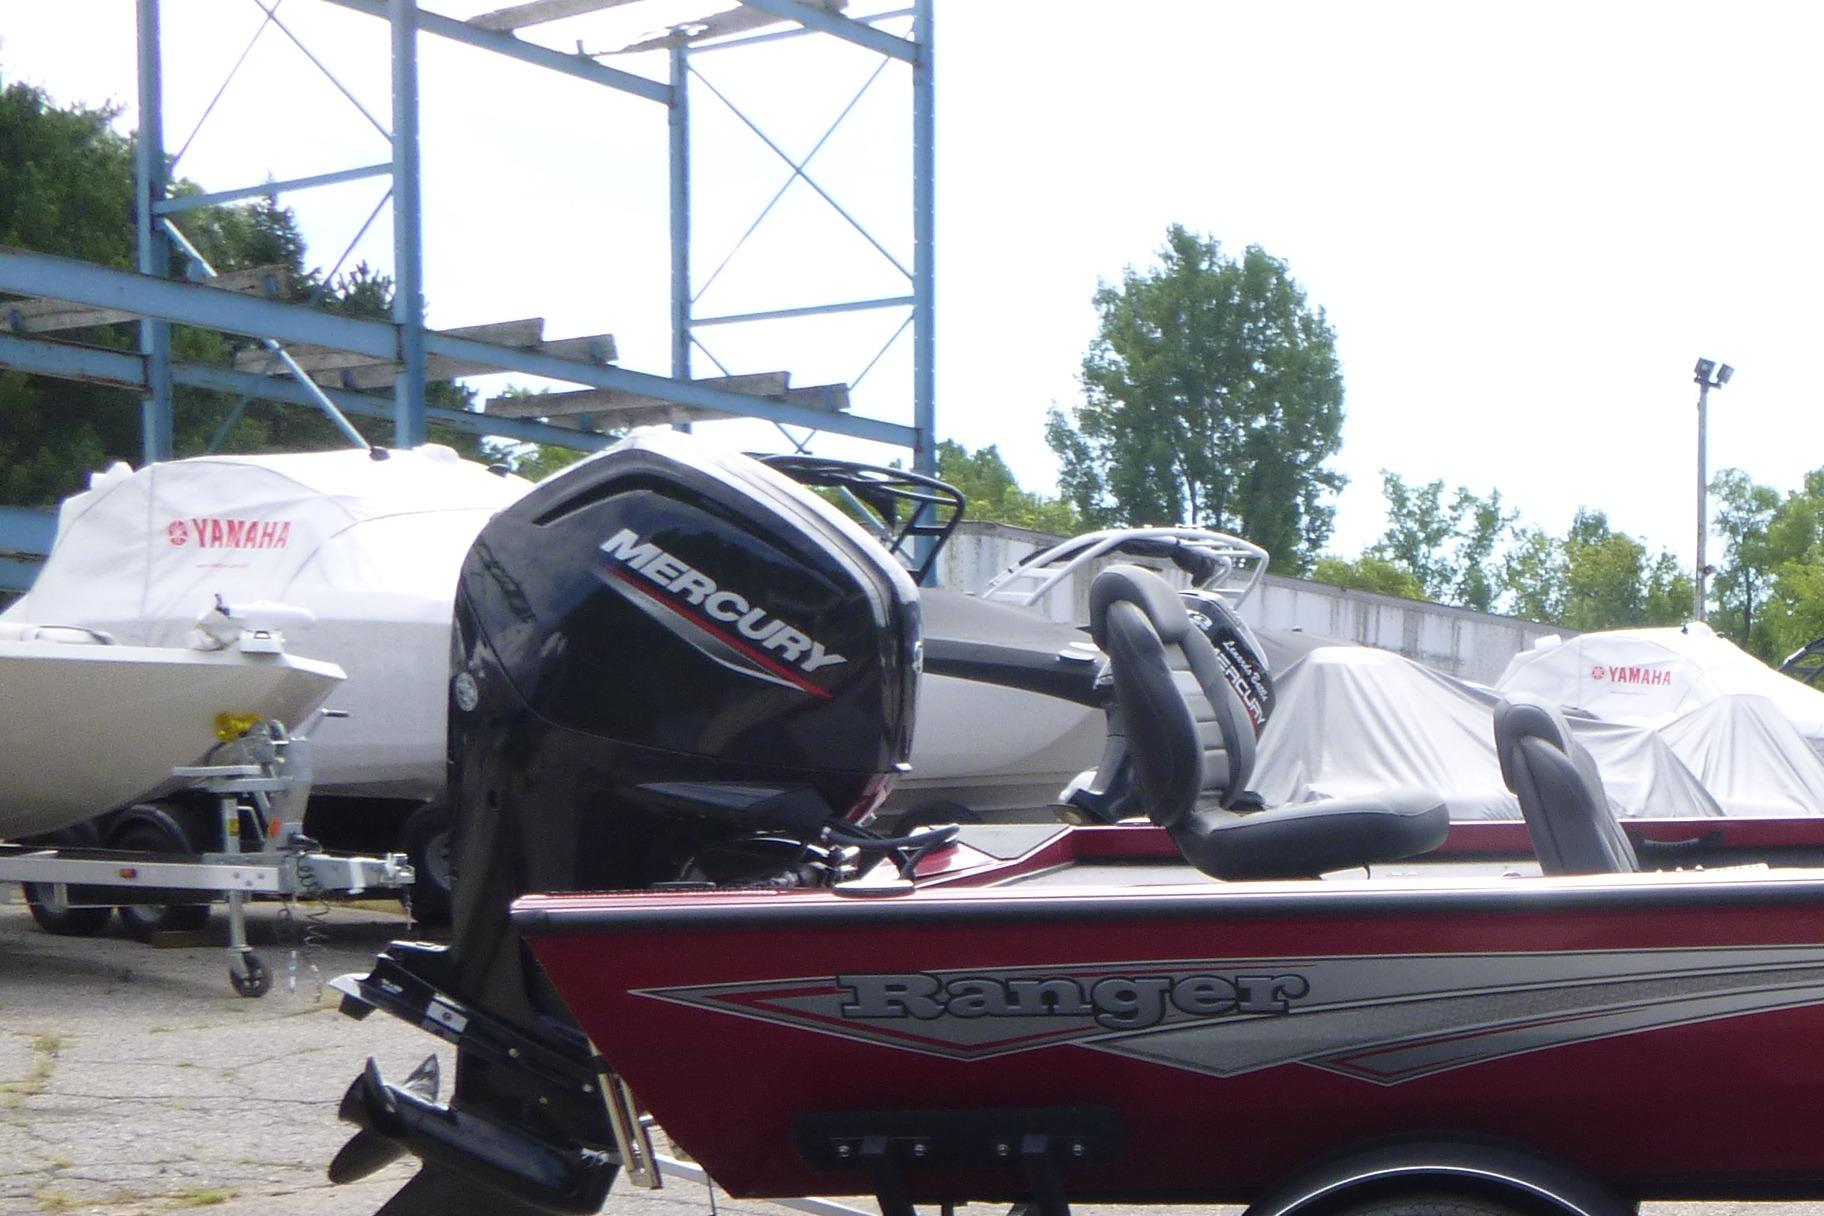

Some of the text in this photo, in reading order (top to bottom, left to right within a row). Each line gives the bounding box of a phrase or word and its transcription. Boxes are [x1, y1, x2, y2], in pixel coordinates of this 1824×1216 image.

[191, 518, 291, 549] YAMAHA
[599, 528, 848, 673] MERCURY
[1608, 666, 1672, 686] YAMAHA
[837, 970, 1311, 1030] Ranger
